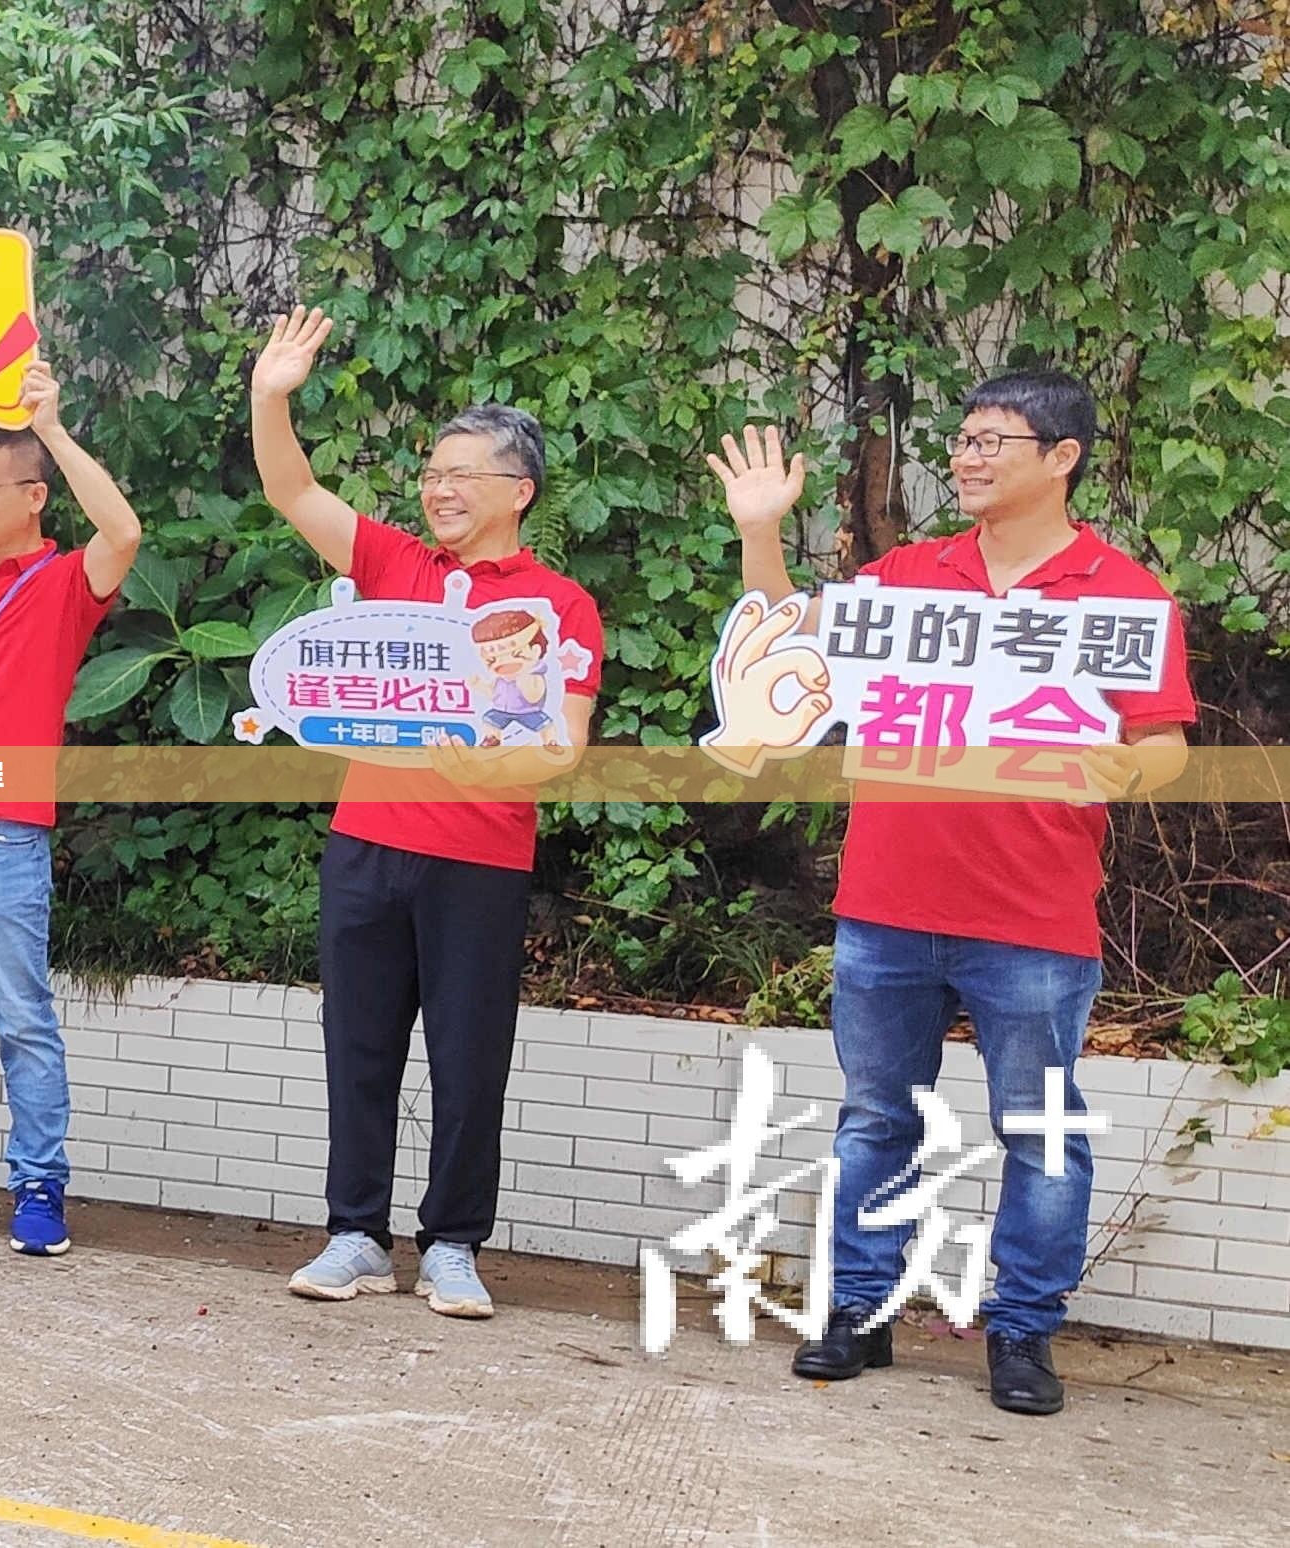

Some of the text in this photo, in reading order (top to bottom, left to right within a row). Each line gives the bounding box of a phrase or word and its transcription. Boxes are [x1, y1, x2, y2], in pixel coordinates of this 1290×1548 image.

[297, 639, 452, 672] 旗开得胜
[825, 598, 1158, 682] 出的考题
[286, 673, 476, 715] 逢考必过
[855, 675, 1107, 791] 都会
